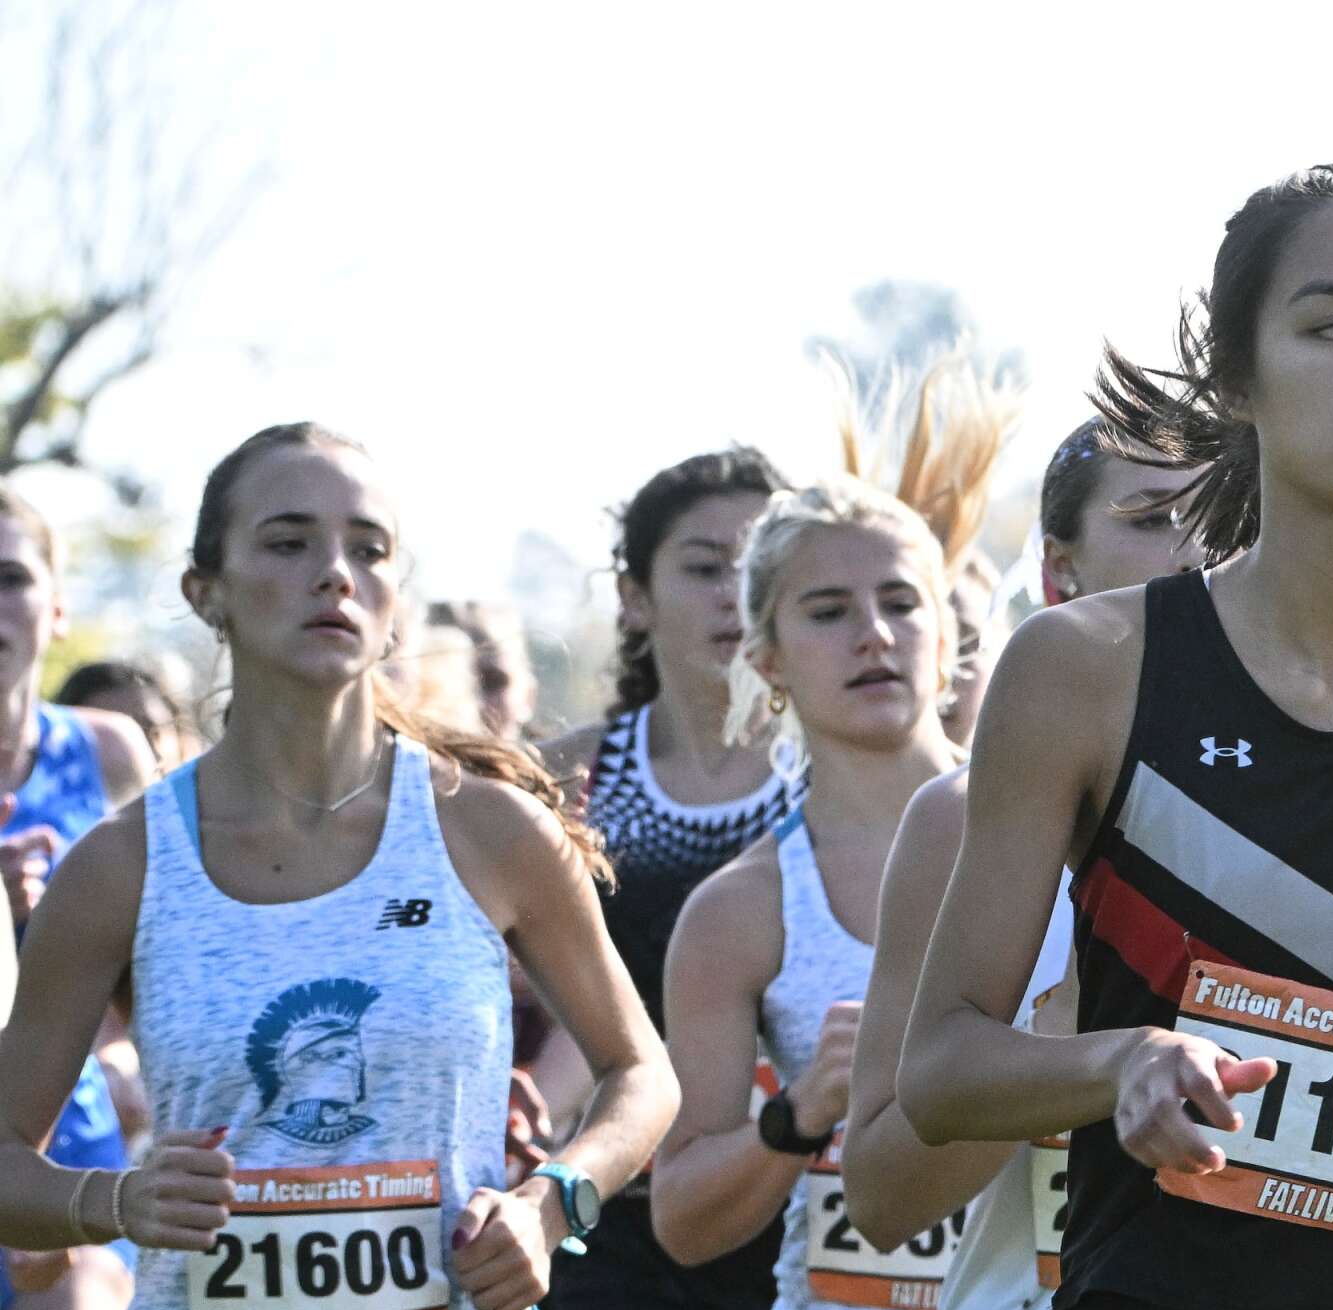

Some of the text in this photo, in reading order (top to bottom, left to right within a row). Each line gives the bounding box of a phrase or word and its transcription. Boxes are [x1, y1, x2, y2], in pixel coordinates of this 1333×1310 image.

[1194, 977, 1282, 1020] Fulton
[263, 1178, 362, 1203] Accurate
[364, 1173, 434, 1199] Timing
[204, 1225, 428, 1297] 21600
